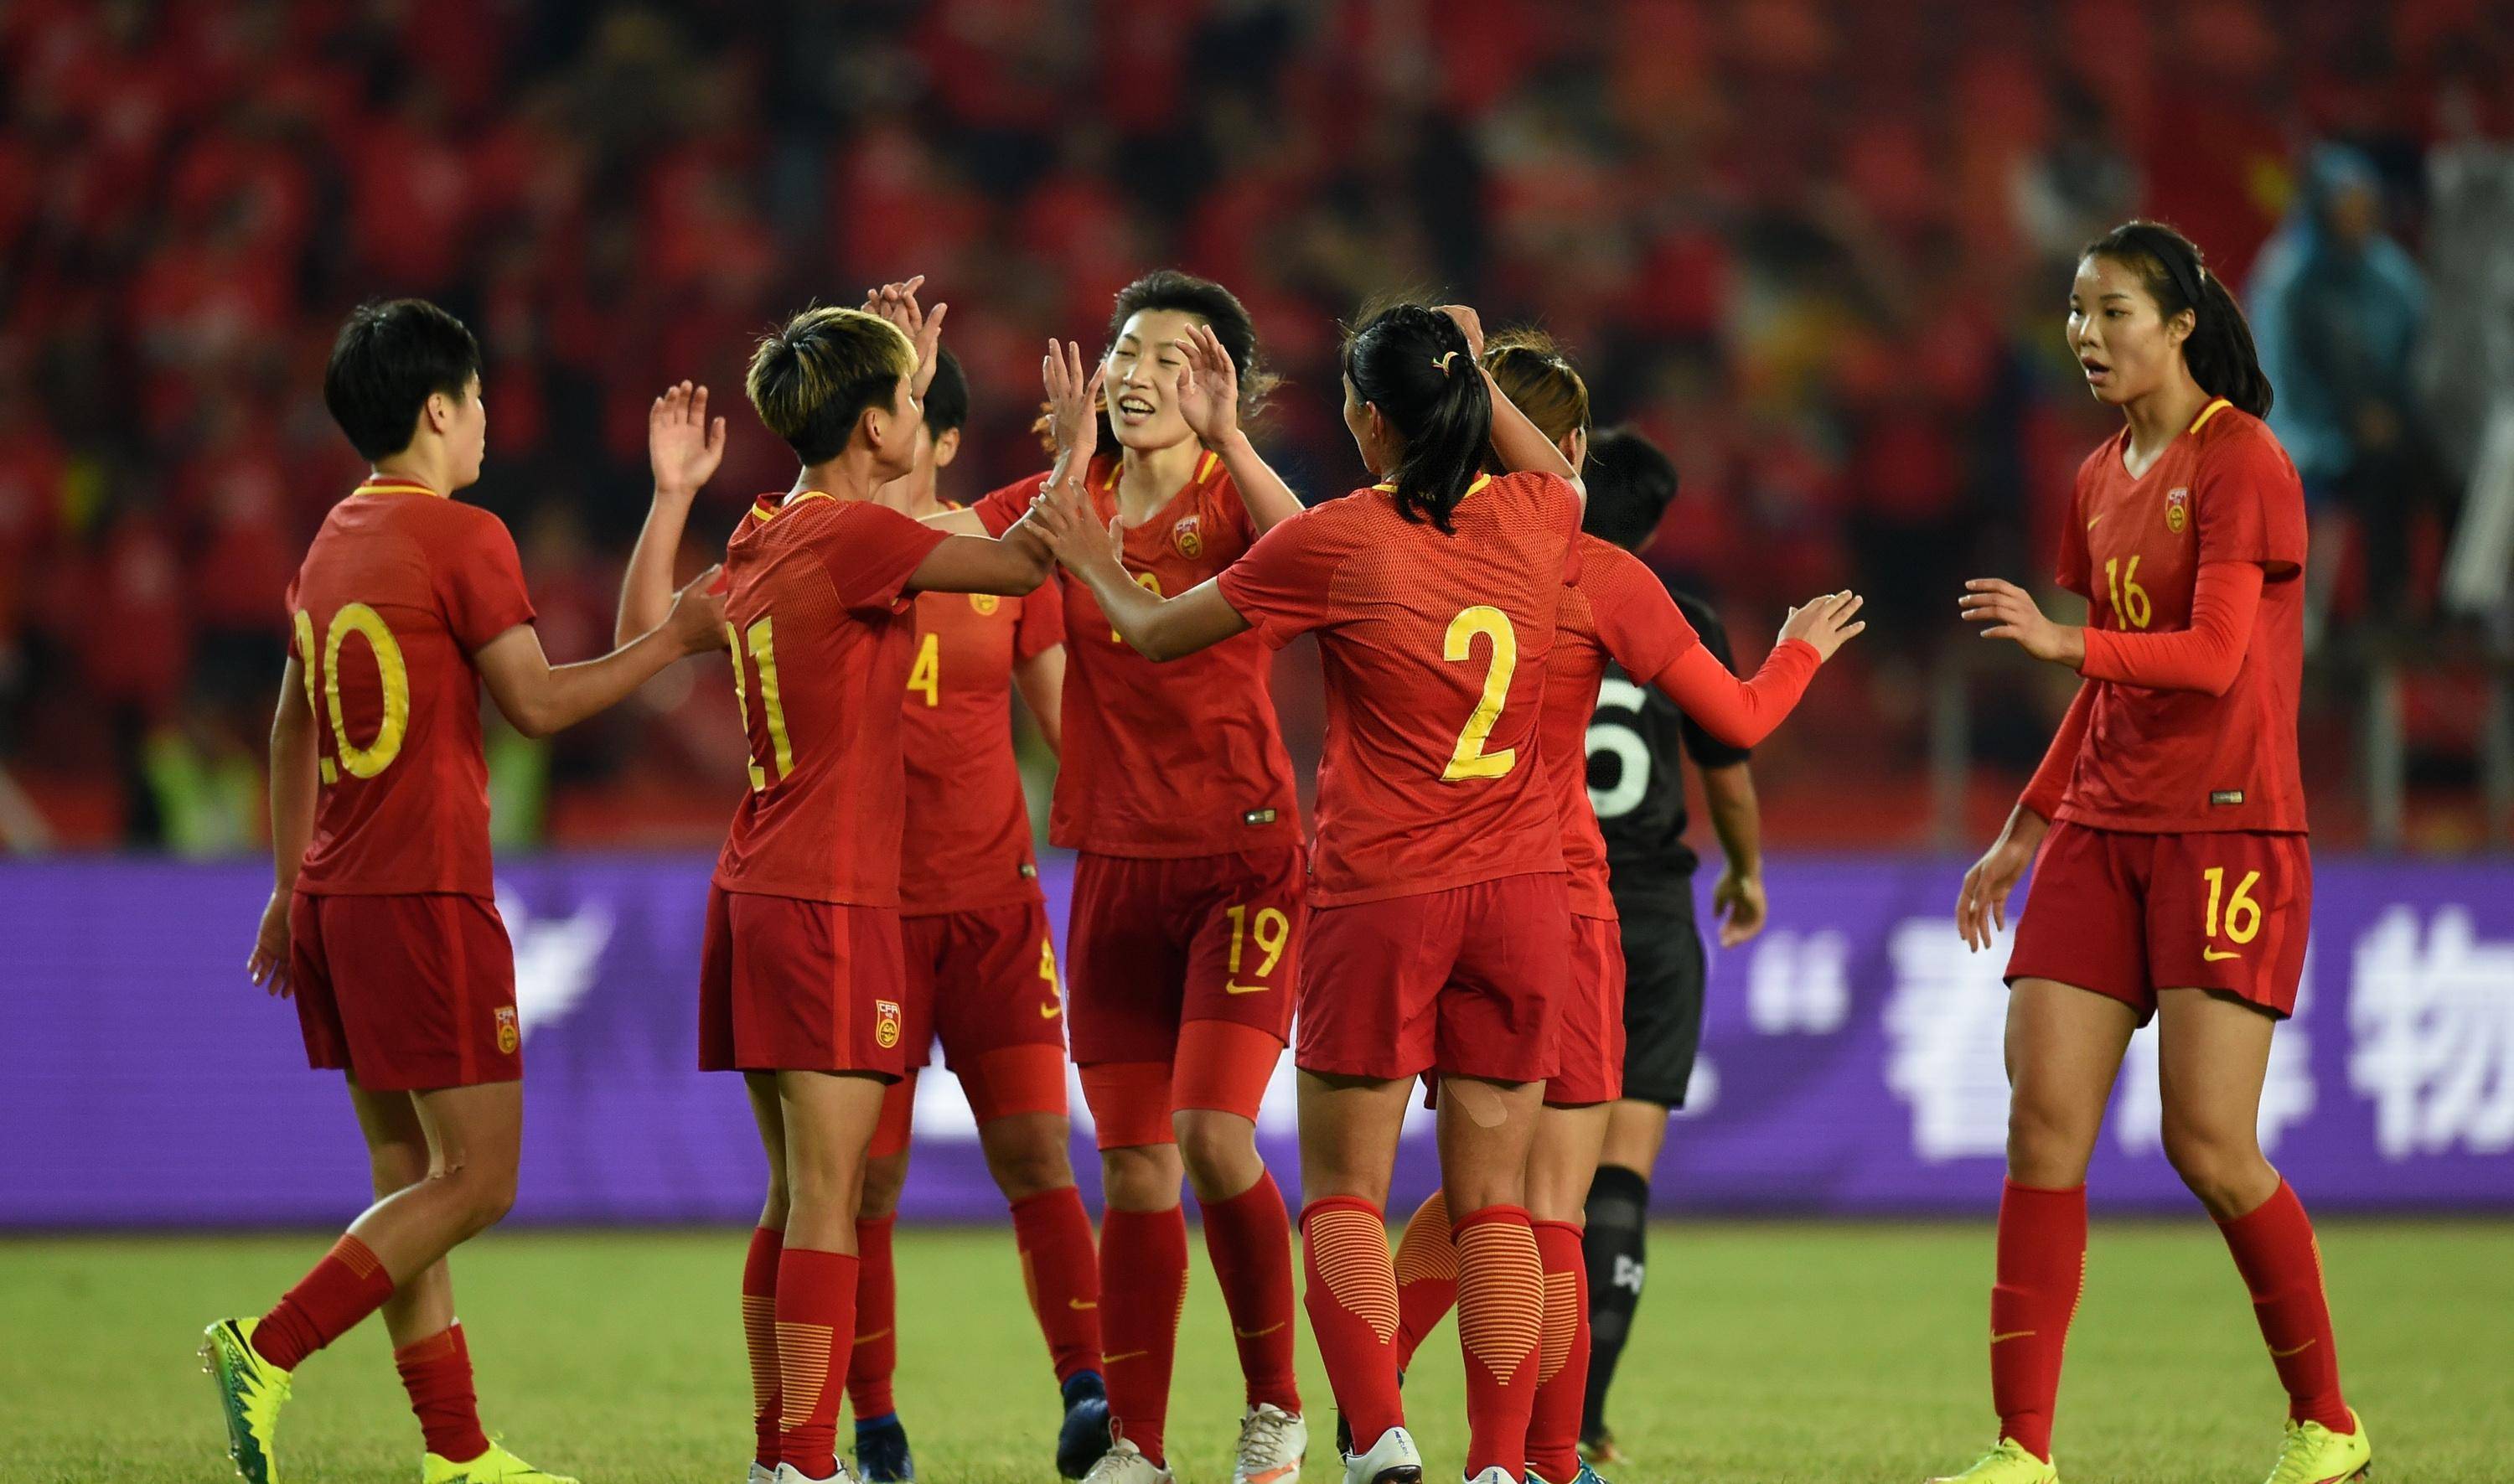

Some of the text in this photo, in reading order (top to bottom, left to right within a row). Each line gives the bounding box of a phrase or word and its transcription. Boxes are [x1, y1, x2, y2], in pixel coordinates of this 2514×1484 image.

[2105, 555, 2151, 631] 16
[907, 633, 939, 707] 4
[1442, 605, 1518, 782] 2
[1226, 904, 1290, 979] 19
[2203, 866, 2262, 944] 16
[878, 1003, 898, 1014] CFA
